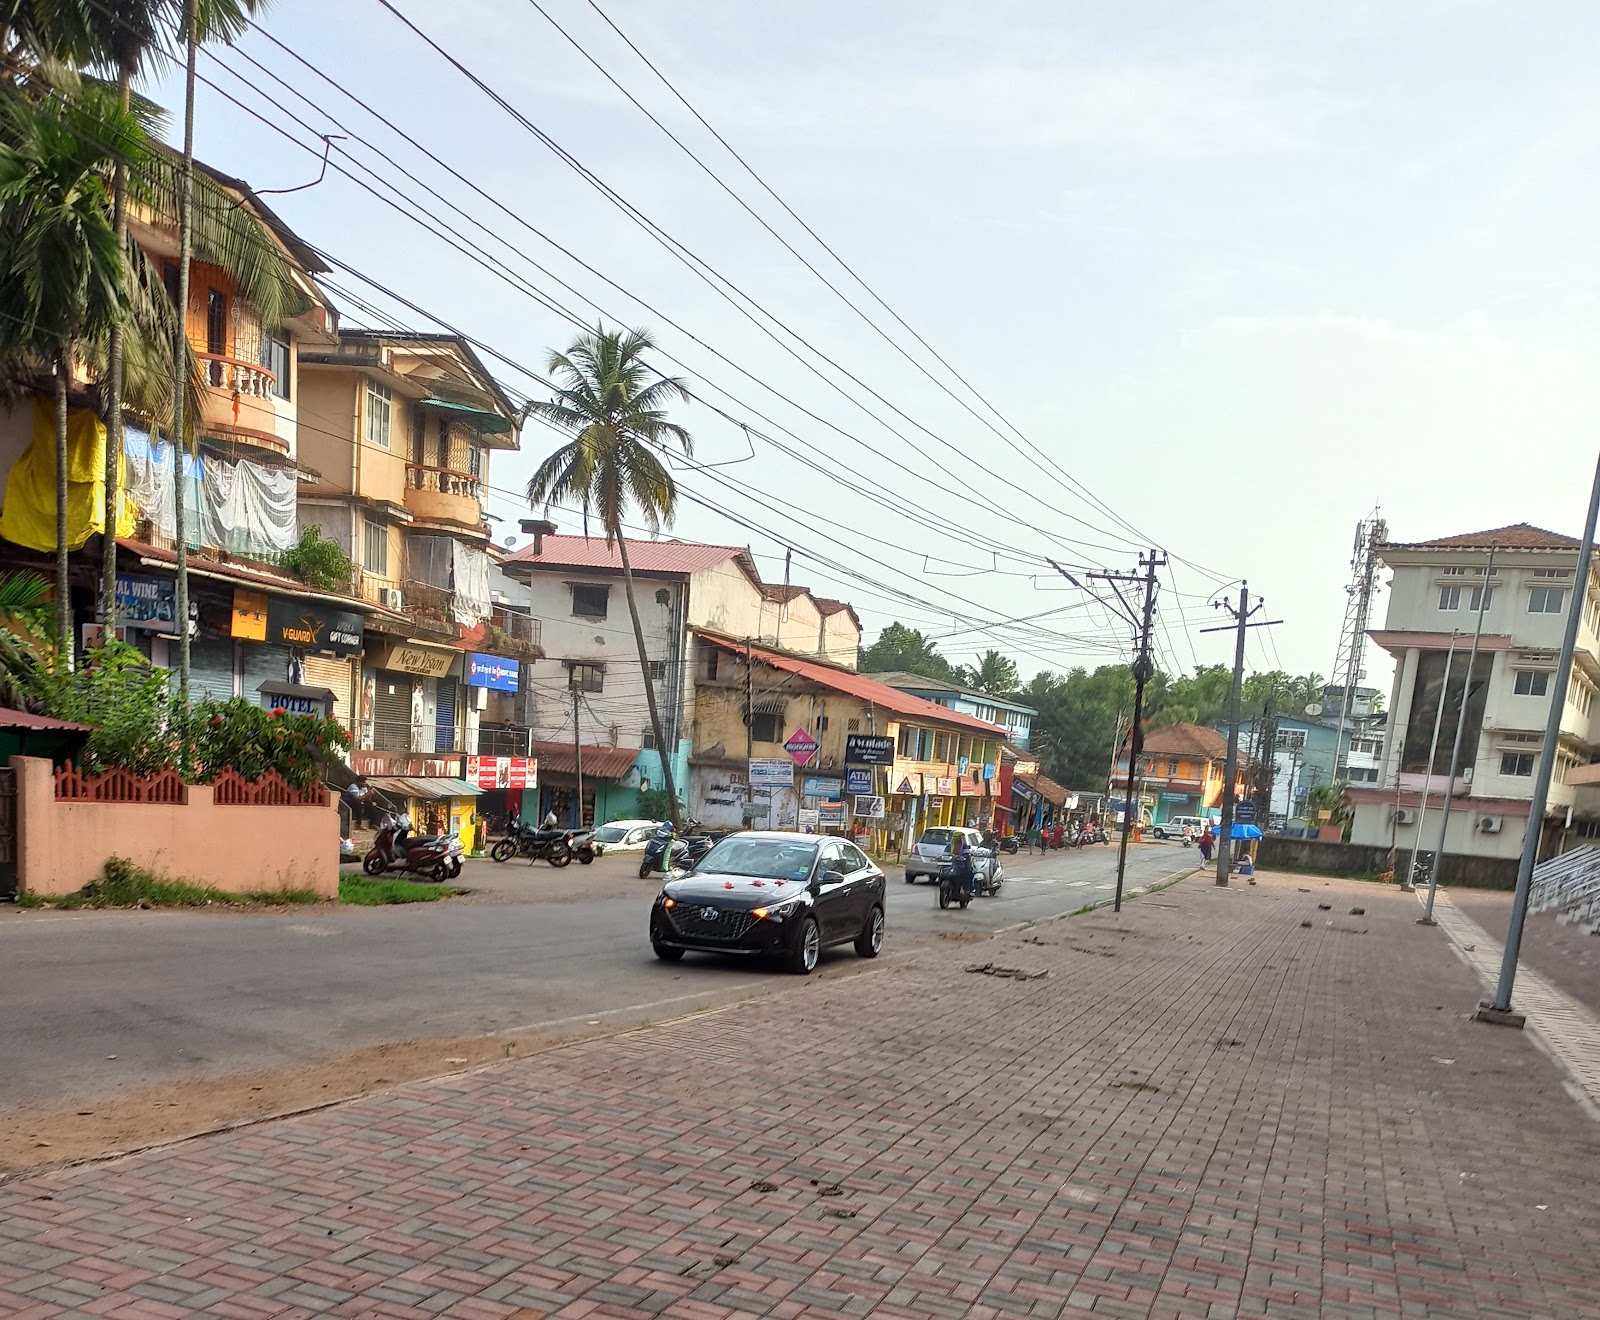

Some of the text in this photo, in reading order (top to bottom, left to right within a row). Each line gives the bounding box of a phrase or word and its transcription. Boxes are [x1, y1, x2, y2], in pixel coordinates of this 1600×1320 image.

[131, 581, 159, 600] WINE
[282, 627, 311, 642] V-GUARD
[329, 631, 360, 646] GIFT CORNER
[396, 649, 421, 666] New
[420, 650, 445, 671] Vision
[270, 694, 315, 714] HOTEL
[849, 771, 871, 781] ATM
